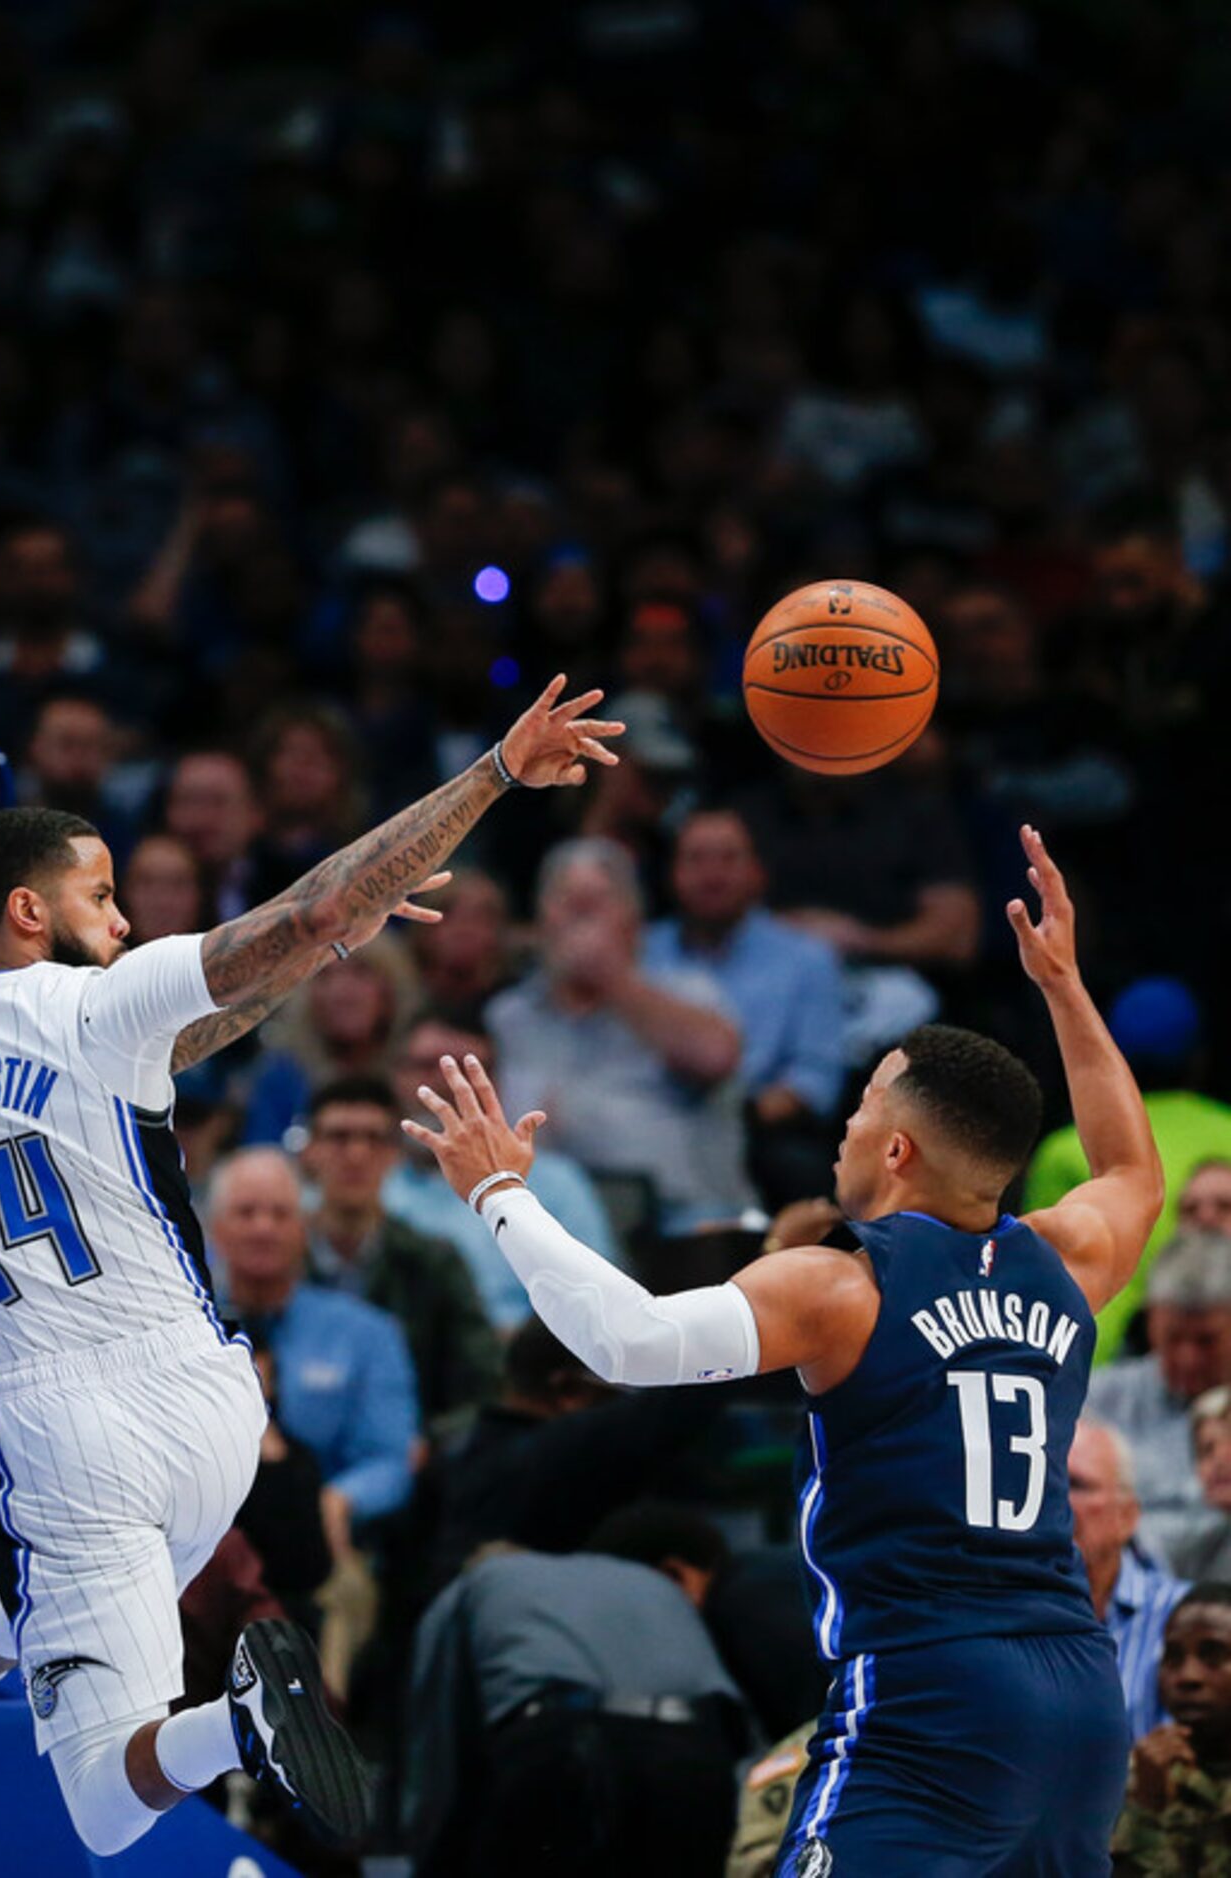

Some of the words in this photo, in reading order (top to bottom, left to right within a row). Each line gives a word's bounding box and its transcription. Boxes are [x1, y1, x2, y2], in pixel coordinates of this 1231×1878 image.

[773, 641, 905, 676] SPALDING
[910, 1289, 1080, 1366] BRUNSON
[946, 1370, 1048, 1532] 13
